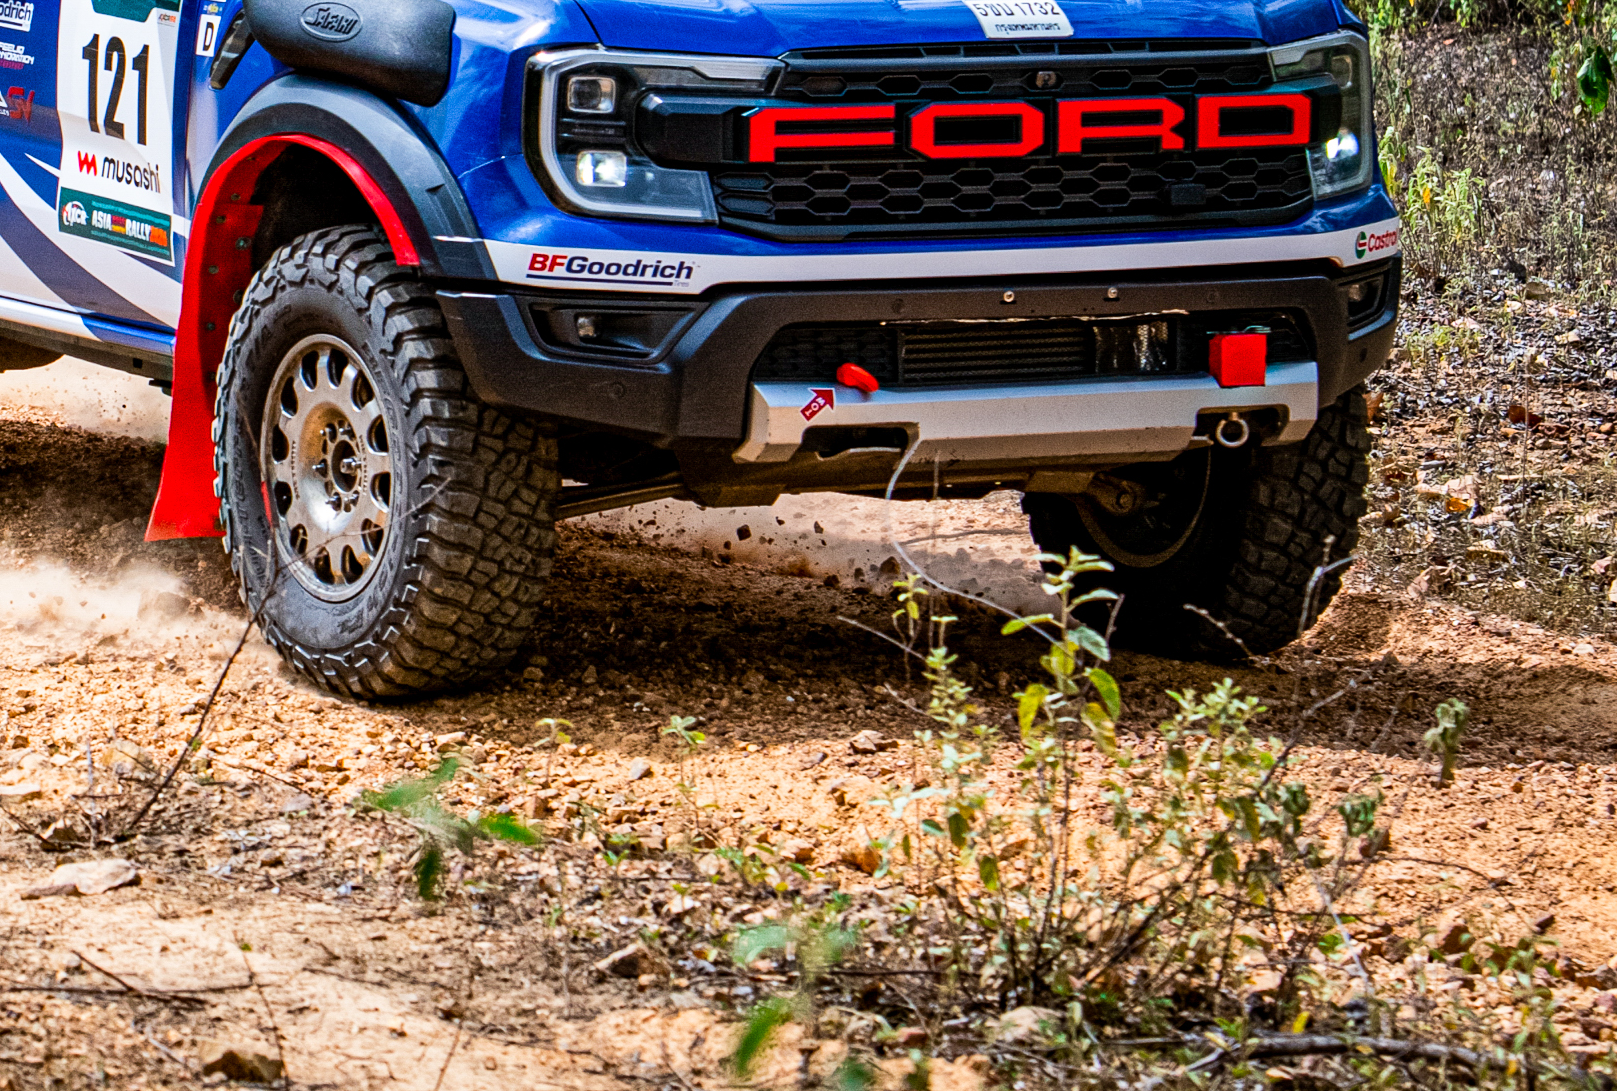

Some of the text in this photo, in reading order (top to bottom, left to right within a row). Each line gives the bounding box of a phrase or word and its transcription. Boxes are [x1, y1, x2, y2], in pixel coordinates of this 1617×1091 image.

[1015, 2, 1062, 16] 1732
[202, 21, 215, 52] D
[81, 33, 150, 147] 121
[748, 93, 1312, 164] FORD
[101, 156, 161, 194] musashi
[91, 209, 112, 231] ASIA
[125, 218, 150, 242] RALLY
[528, 253, 694, 280] BFGoodrich
